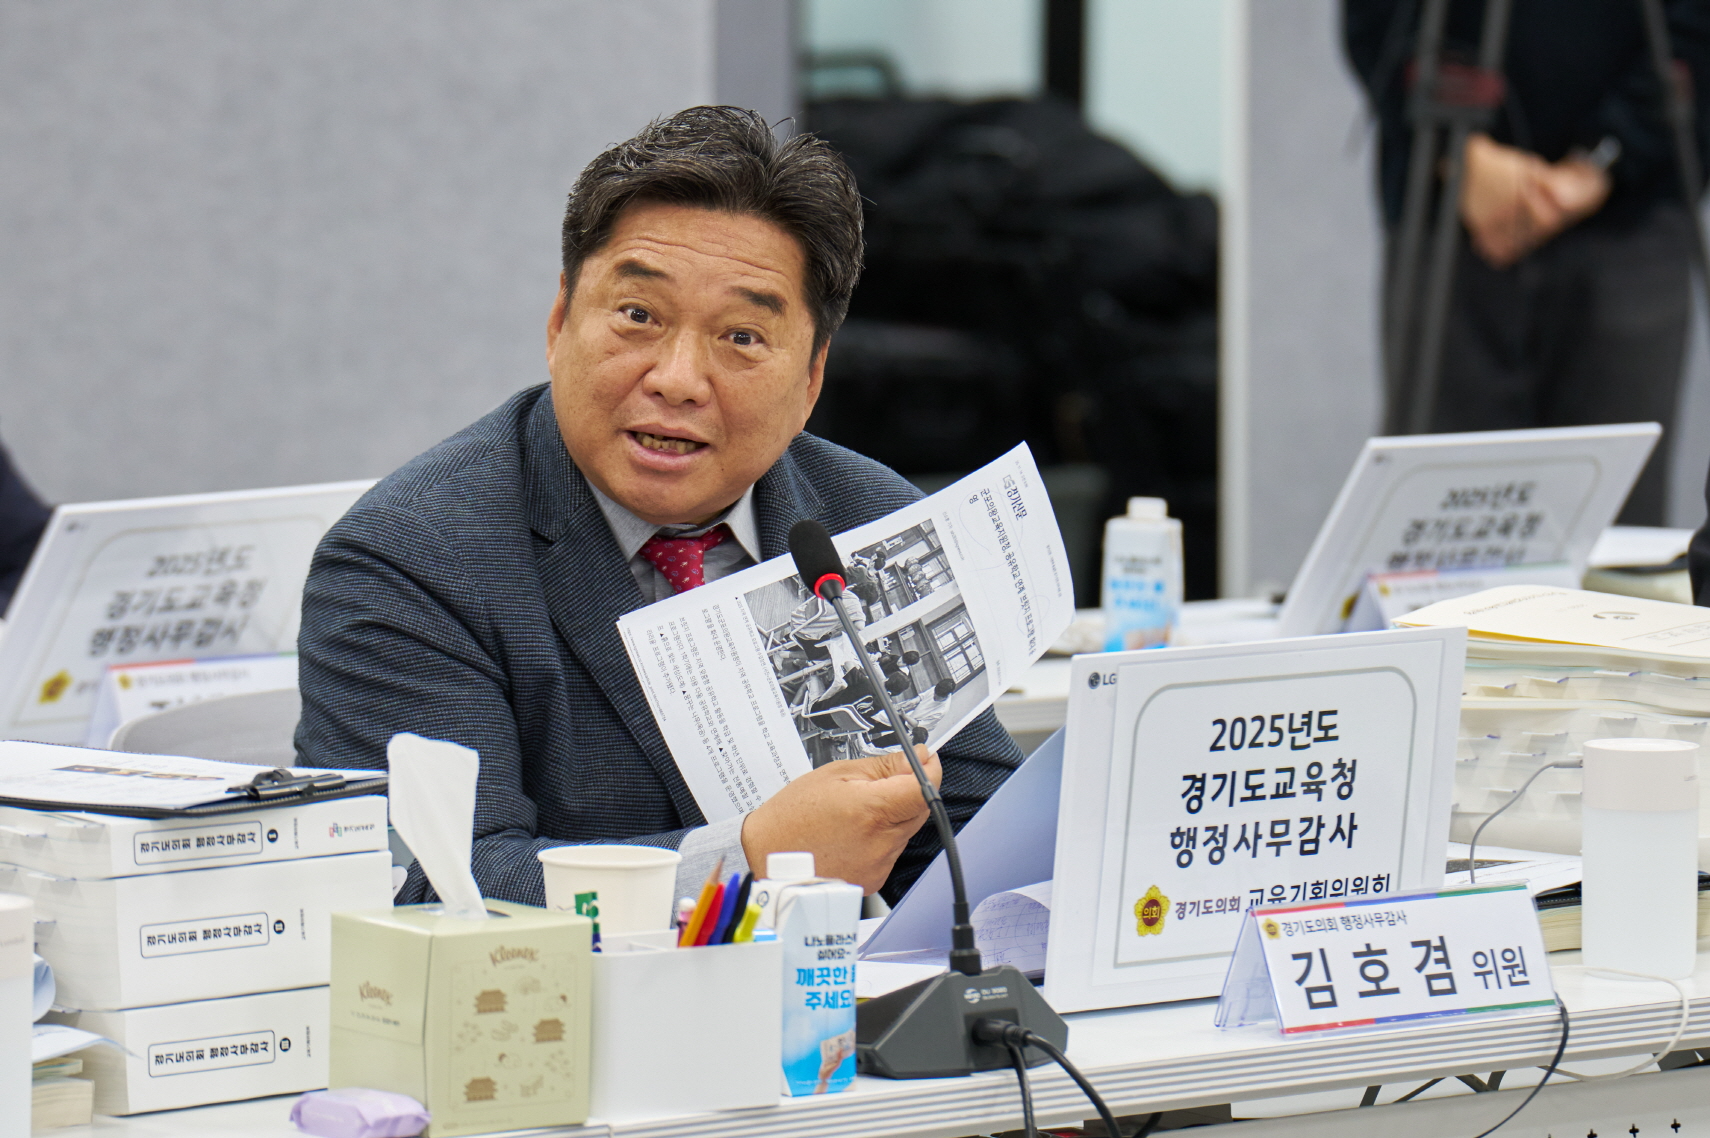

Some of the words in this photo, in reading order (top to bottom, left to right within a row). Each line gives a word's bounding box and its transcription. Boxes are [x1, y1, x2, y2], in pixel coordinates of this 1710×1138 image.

[968, 494, 978, 504] 영
[1006, 486, 1027, 520] 경기신문
[1005, 551, 1020, 579] 공유학교
[1014, 578, 1025, 594] 연계
[1102, 672, 1117, 686] LG
[1209, 709, 1340, 752] 2025년도
[1181, 757, 1358, 815] 경기도교육청
[140, 838, 191, 853] 경기도의회
[196, 831, 256, 848] 행정사무감사
[1170, 812, 1358, 869] 행정사무감사
[1175, 896, 1241, 920] 경기도의회
[146, 930, 197, 946] 경기도의회
[202, 923, 263, 941] 행정사무감사
[1281, 916, 1339, 937] 경기도의회
[1340, 910, 1408, 931] 행정사무감사
[796, 966, 848, 986] 깨끗한
[1472, 946, 1530, 990] 위원
[805, 989, 852, 1010] 주세요
[154, 1049, 205, 1066] 경기도의회
[209, 1041, 269, 1058] 행정사무감사
